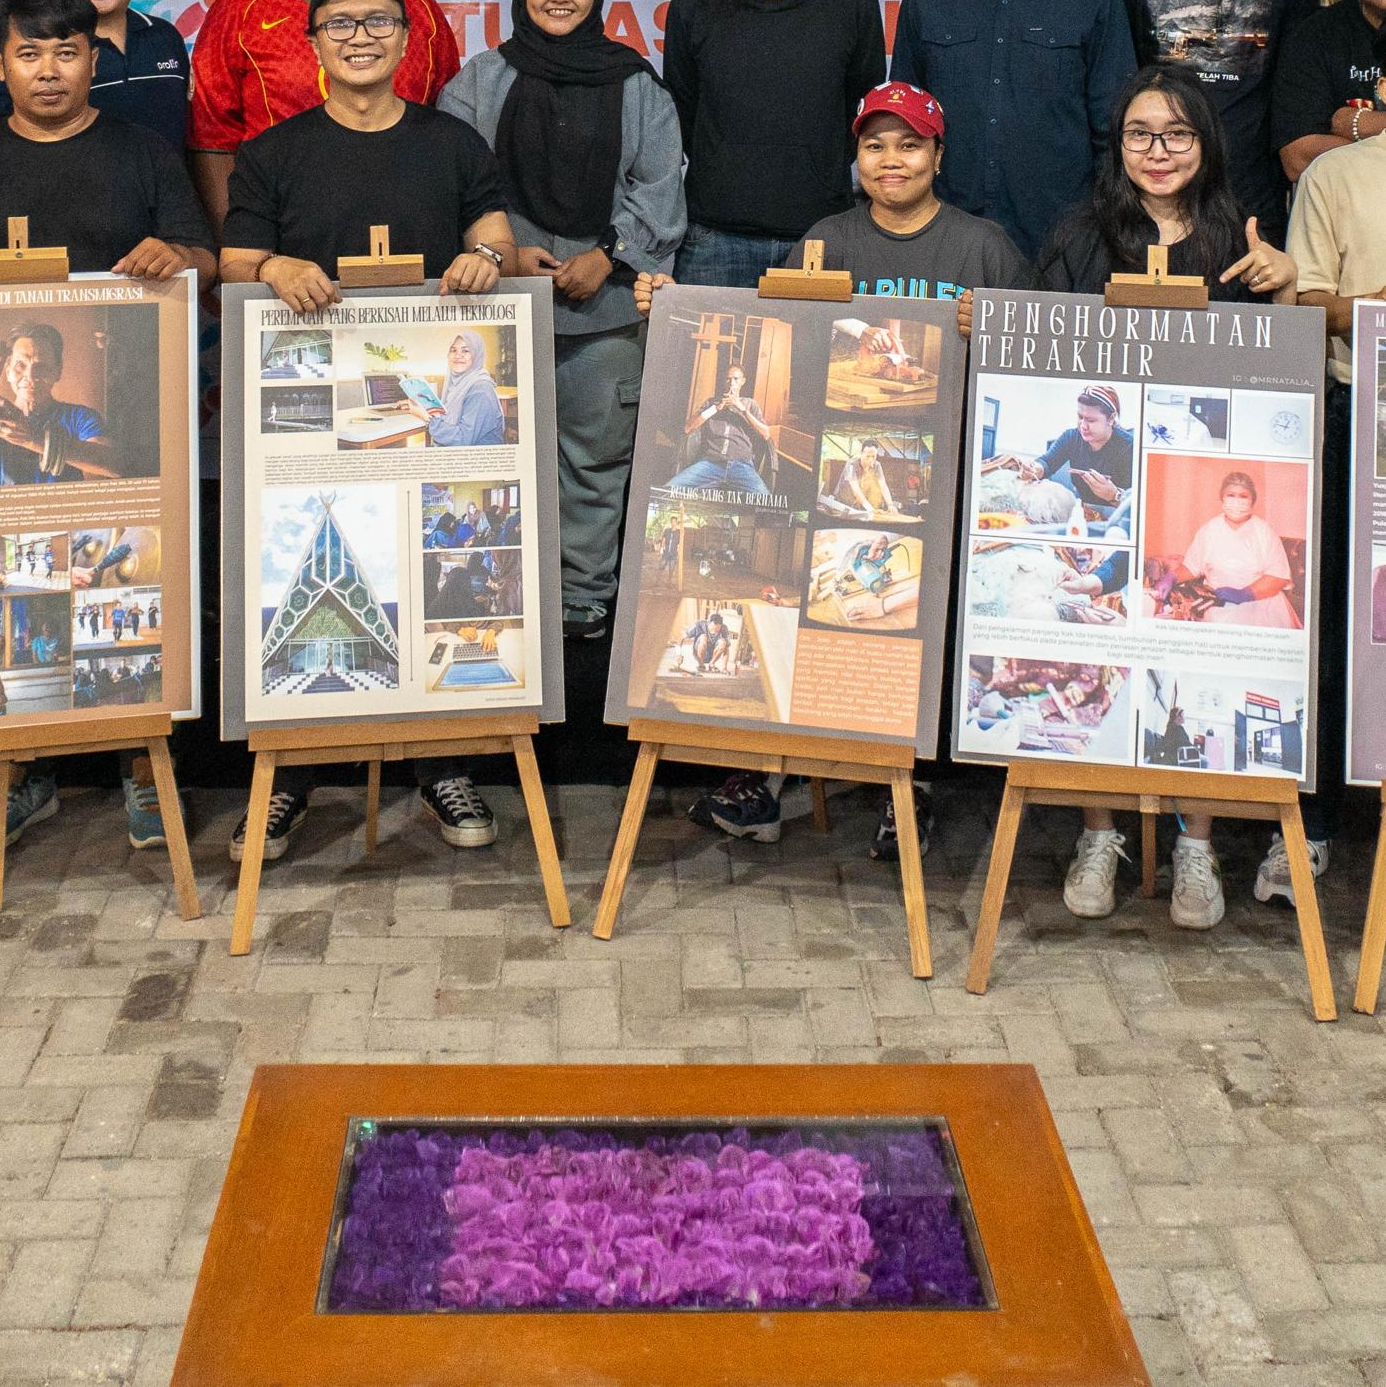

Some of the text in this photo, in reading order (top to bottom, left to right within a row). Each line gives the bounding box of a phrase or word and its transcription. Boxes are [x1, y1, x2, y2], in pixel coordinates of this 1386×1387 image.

[1222, 73, 1240, 82] TIBA
[0, 291, 11, 304] DI
[14, 289, 53, 304] TANAH
[56, 286, 144, 303] TRANSMIGRASI
[261, 303, 517, 326] PEREMPUAN YANG BERKISAH MELALUI TEKNOLOGI
[979, 299, 1273, 349] PENGHORMATAN
[978, 334, 1154, 378] TERAKHIR
[670, 485, 789, 509] RUANG YANG TAK BERNAMA
